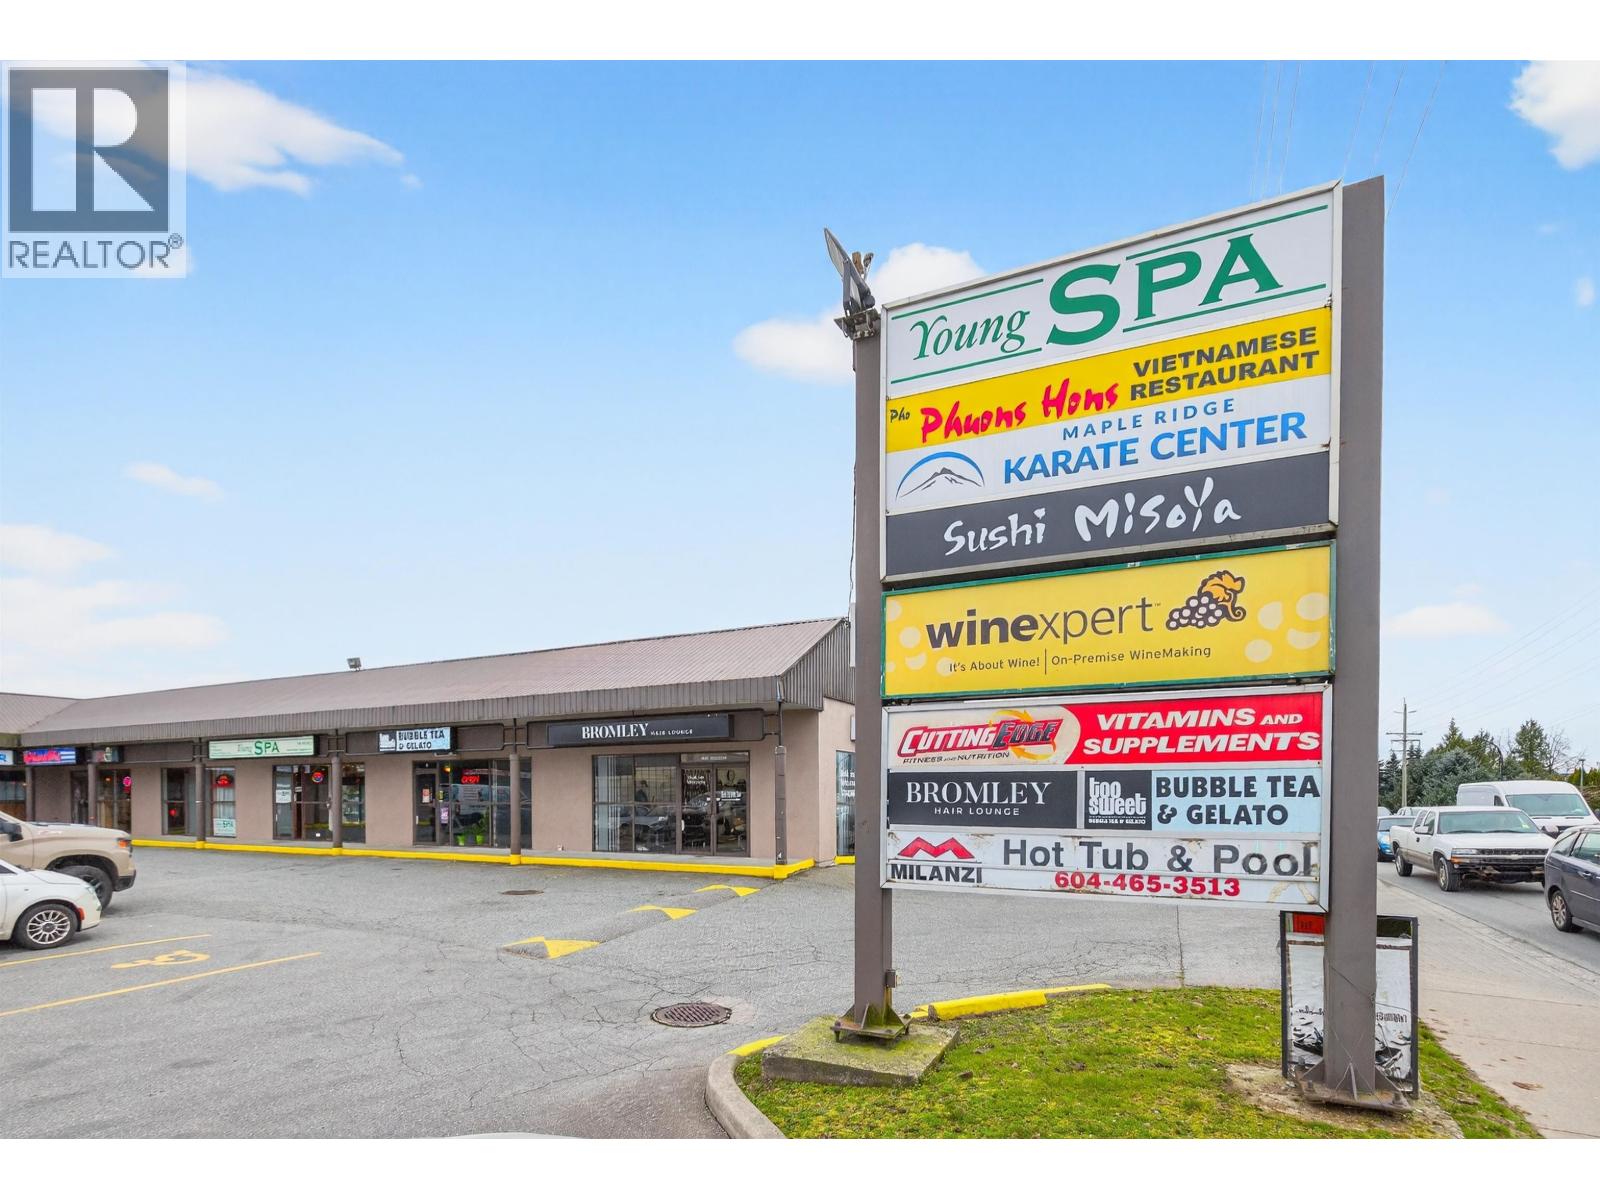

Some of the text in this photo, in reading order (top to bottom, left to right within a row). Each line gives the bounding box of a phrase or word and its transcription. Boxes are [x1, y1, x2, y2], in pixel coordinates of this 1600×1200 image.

[910, 233, 1283, 361] Young SPA
[1133, 326, 1318, 378] VIETNAMESE
[1129, 350, 1320, 401] RESTAURANT
[890, 408, 910, 423] Pho
[1062, 398, 1235, 441] MAPLE RIDGE
[1004, 411, 1307, 484] KARATE CENTER
[944, 507, 1046, 557] Sushi
[949, 656, 1040, 672] It's About Wine!
[1051, 646, 1212, 666] On-Premise WineMaking
[582, 723, 649, 739] BROMLEY
[1097, 708, 1303, 731] VITAMINS AND
[254, 741, 280, 755] SPA
[1083, 732, 1321, 755] SUPPLEMENTS
[903, 756, 943, 764] FITNESS
[957, 751, 1010, 761] NUTRITION
[906, 781, 1052, 805] BROMLEY
[1089, 777, 1121, 799] too
[1156, 775, 1321, 798] BUBBLE TEA
[934, 806, 1020, 816] HAIR LOUNGE
[1089, 793, 1147, 815] sweet
[1157, 804, 1289, 826] & GELATO
[1003, 839, 1312, 877] Hot Tub & Pool
[891, 863, 983, 884] MILANZI
[1055, 870, 1241, 897] 604-465-3513
